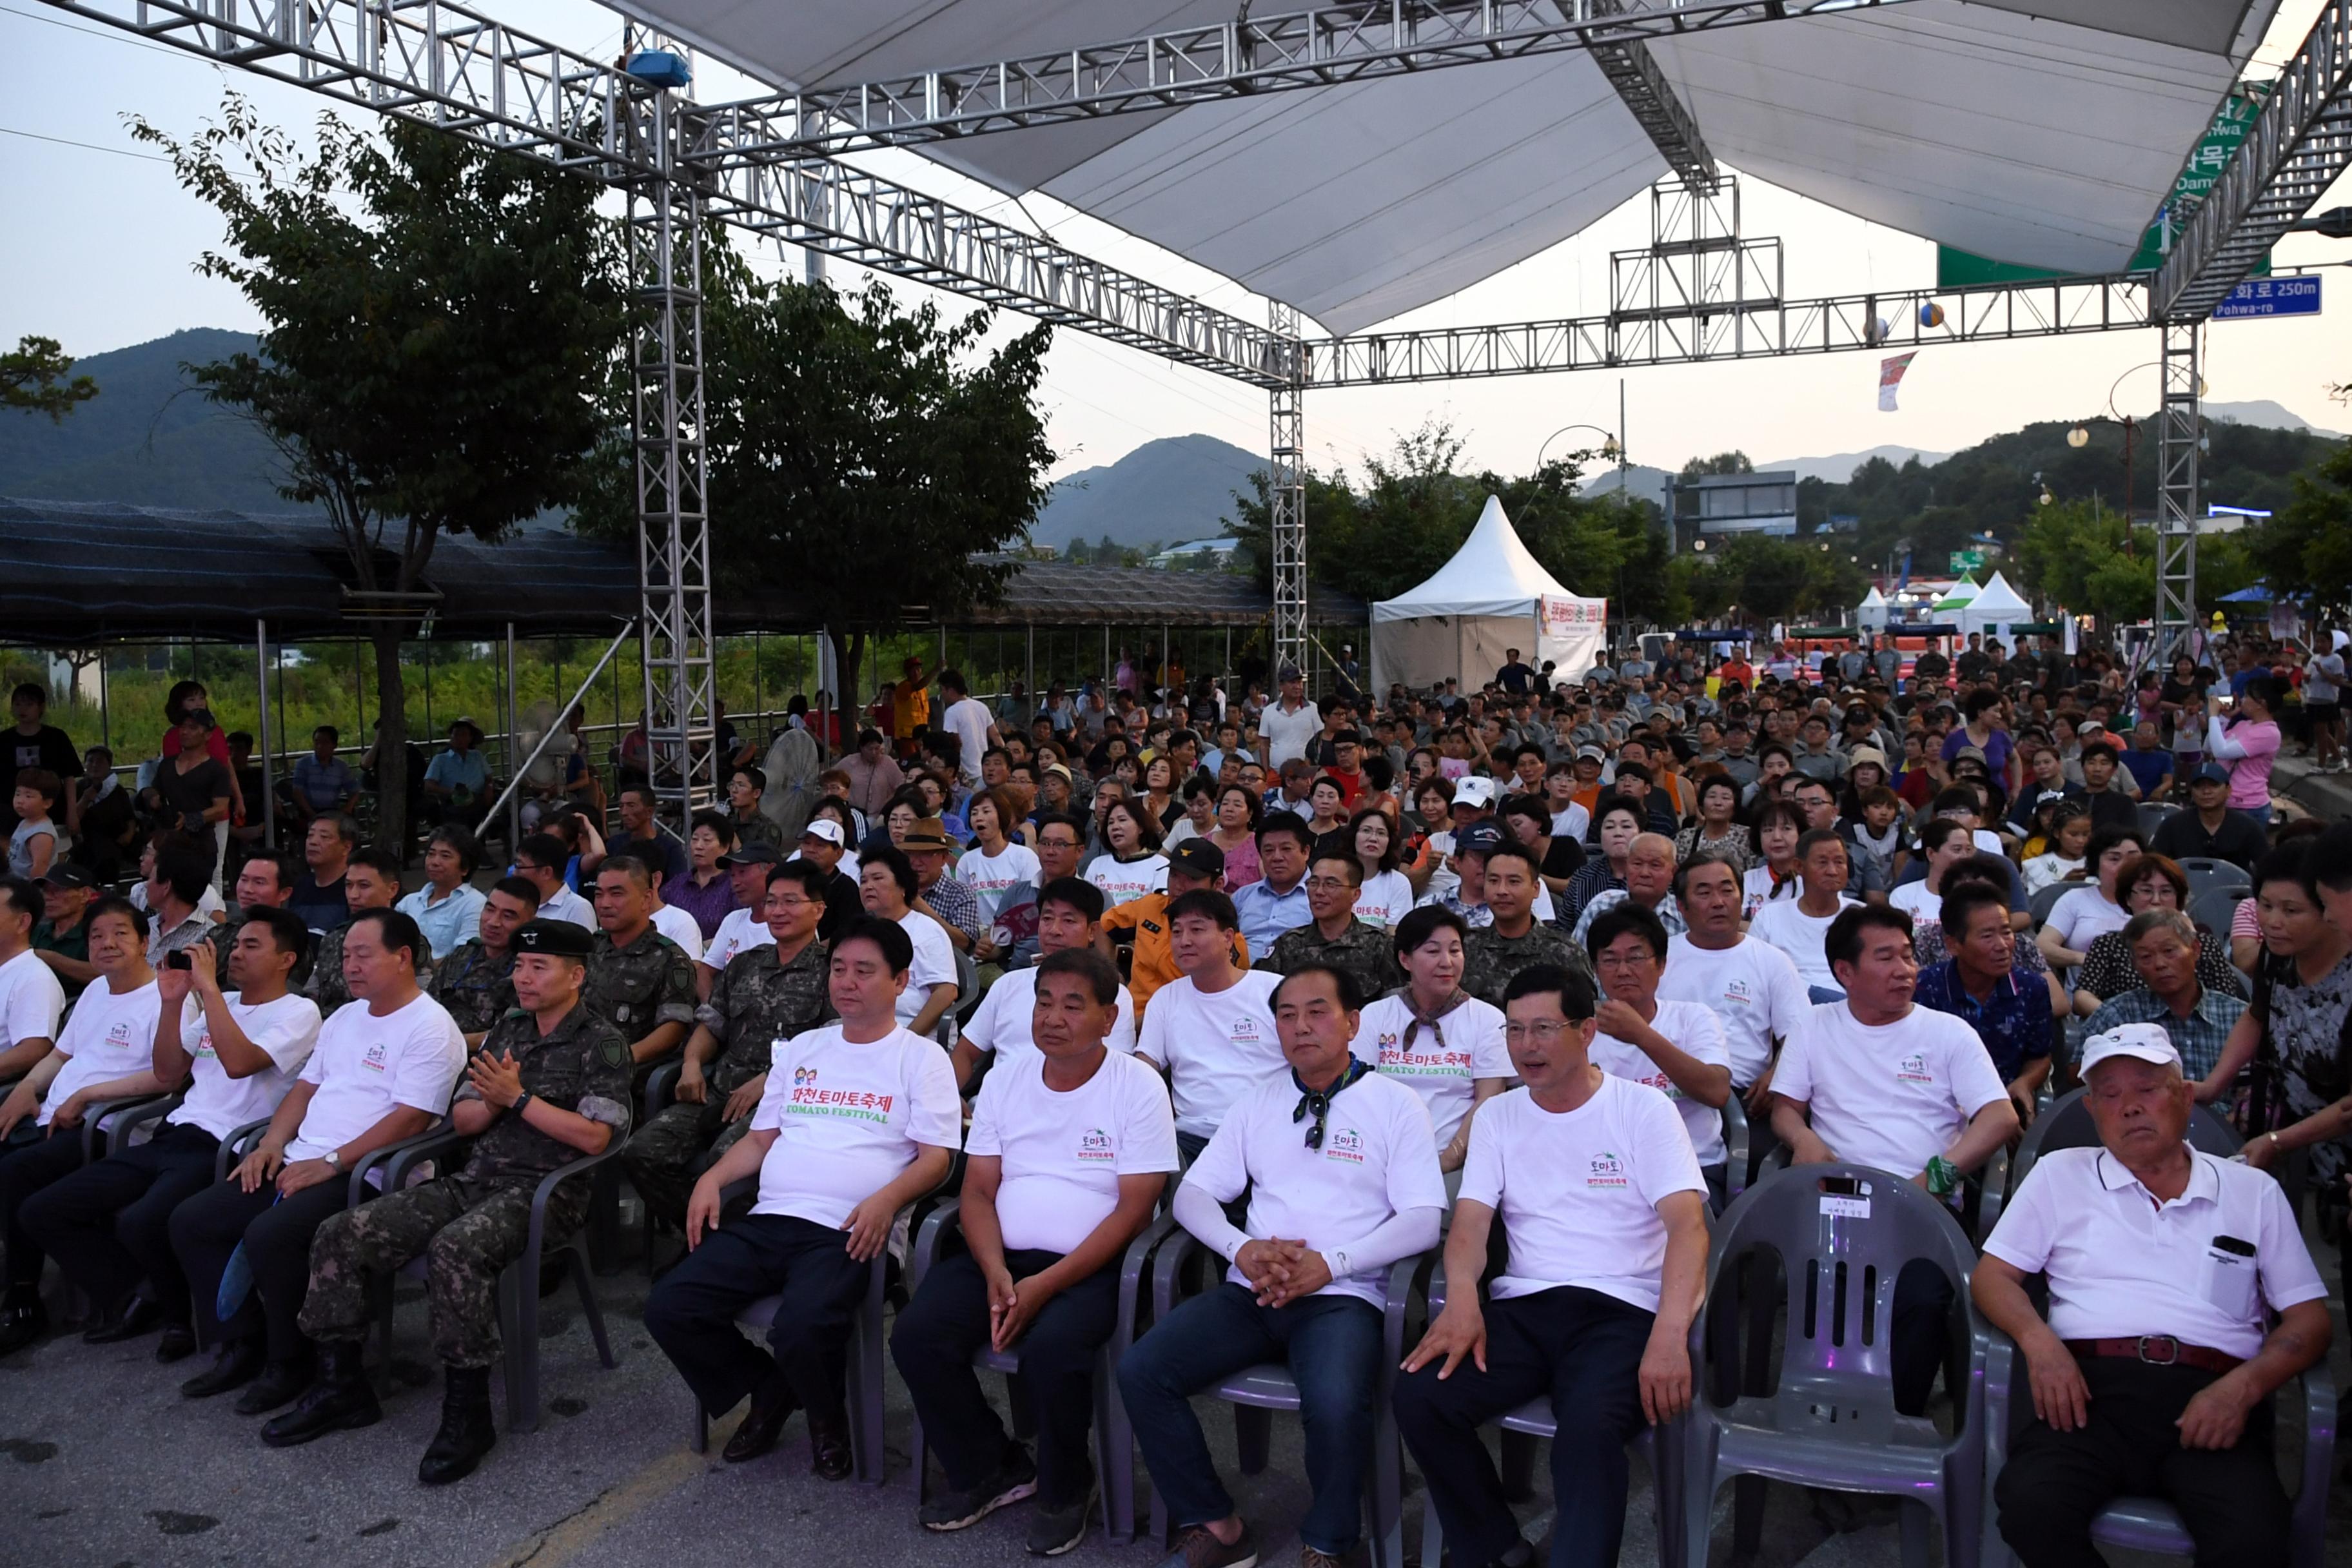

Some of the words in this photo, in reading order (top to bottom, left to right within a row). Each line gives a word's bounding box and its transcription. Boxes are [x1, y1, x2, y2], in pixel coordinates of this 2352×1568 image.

[2226, 282, 2273, 300] 화로
[2277, 282, 2317, 297] 250m
[2217, 304, 2273, 315] Pohwa-ro
[1418, 1068, 1471, 1077] FESTIVAL
[787, 1104, 829, 1115] TOMATO
[832, 1107, 888, 1124] FESTIVAL
[1082, 1136, 1107, 1146] 토마토
[1331, 1134, 1358, 1148] 토마토
[1591, 1161, 1619, 1172] 토마토
